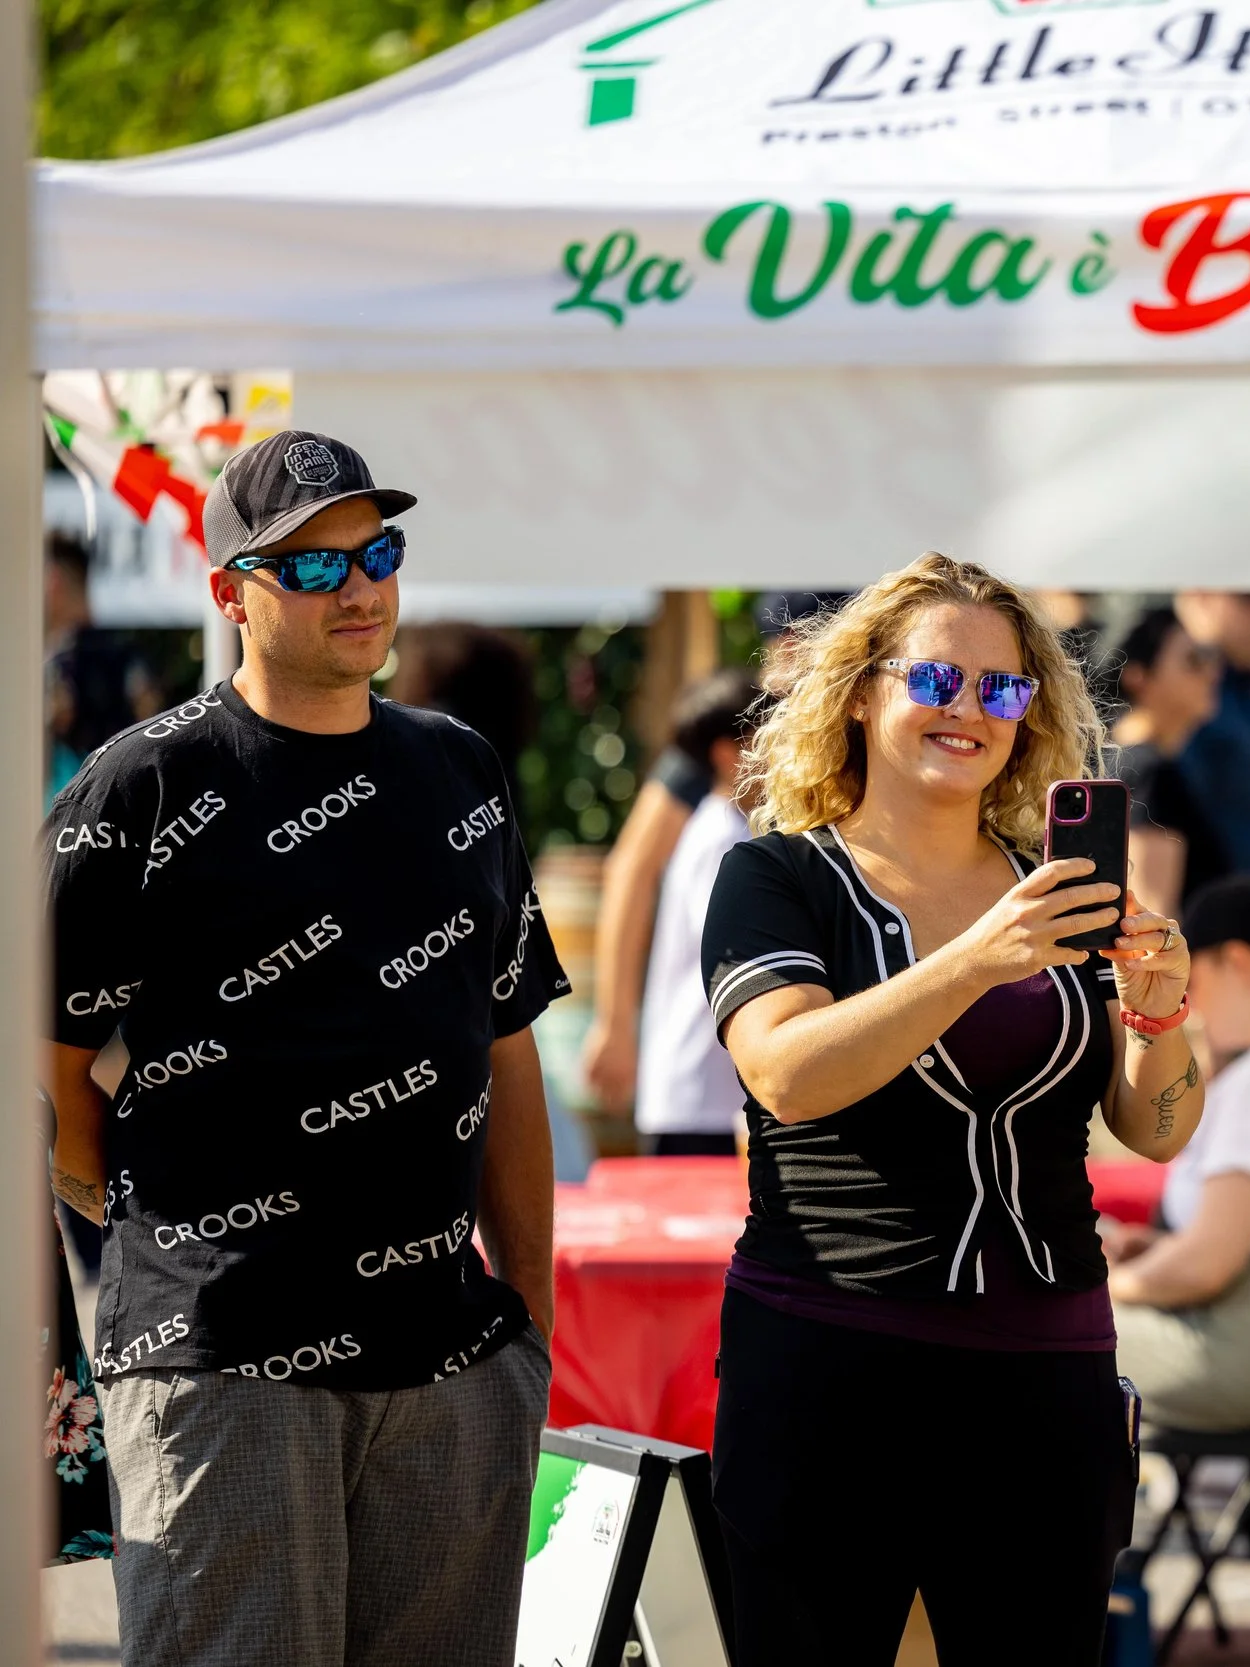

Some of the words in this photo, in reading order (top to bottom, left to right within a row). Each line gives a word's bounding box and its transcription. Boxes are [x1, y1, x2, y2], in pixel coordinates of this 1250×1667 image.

[768, 24, 1097, 107] Little
[554, 231, 692, 328] La
[703, 198, 1049, 321] Vita
[1068, 231, 1118, 298] è
[289, 453, 303, 465] IN
[304, 448, 328, 458] THE
[294, 443, 315, 453] GET
[294, 455, 333, 472] GAME
[266, 774, 377, 853] CROOKS
[218, 914, 343, 1002] CASTLES
[379, 908, 475, 989] CROOKS
[300, 1059, 438, 1134] CASTLES
[455, 1071, 492, 1141] CROO
[154, 1191, 300, 1250] CROOKS
[356, 1211, 469, 1278] CASTLES
[220, 1333, 362, 1381] ROOKS
